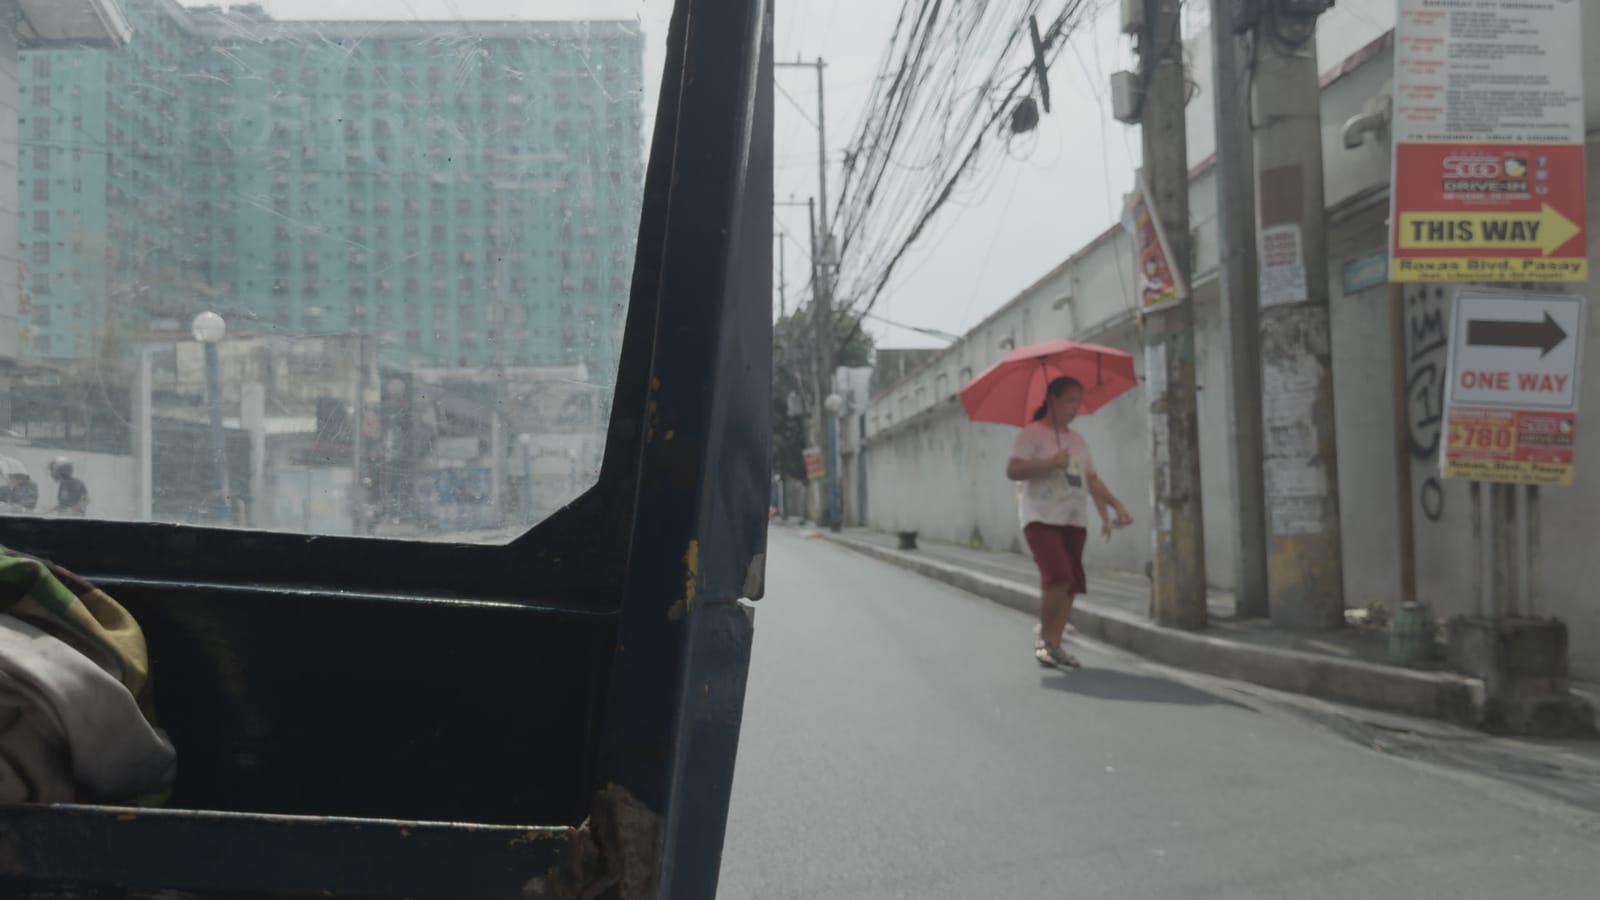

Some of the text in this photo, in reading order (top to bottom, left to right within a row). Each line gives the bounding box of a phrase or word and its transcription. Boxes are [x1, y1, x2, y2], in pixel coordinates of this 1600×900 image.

[1411, 220, 1541, 242] THIS WAY
[1400, 260, 1459, 271] Roxas
[1523, 260, 1581, 273] Pasay
[1460, 370, 1568, 393] ONE WAY
